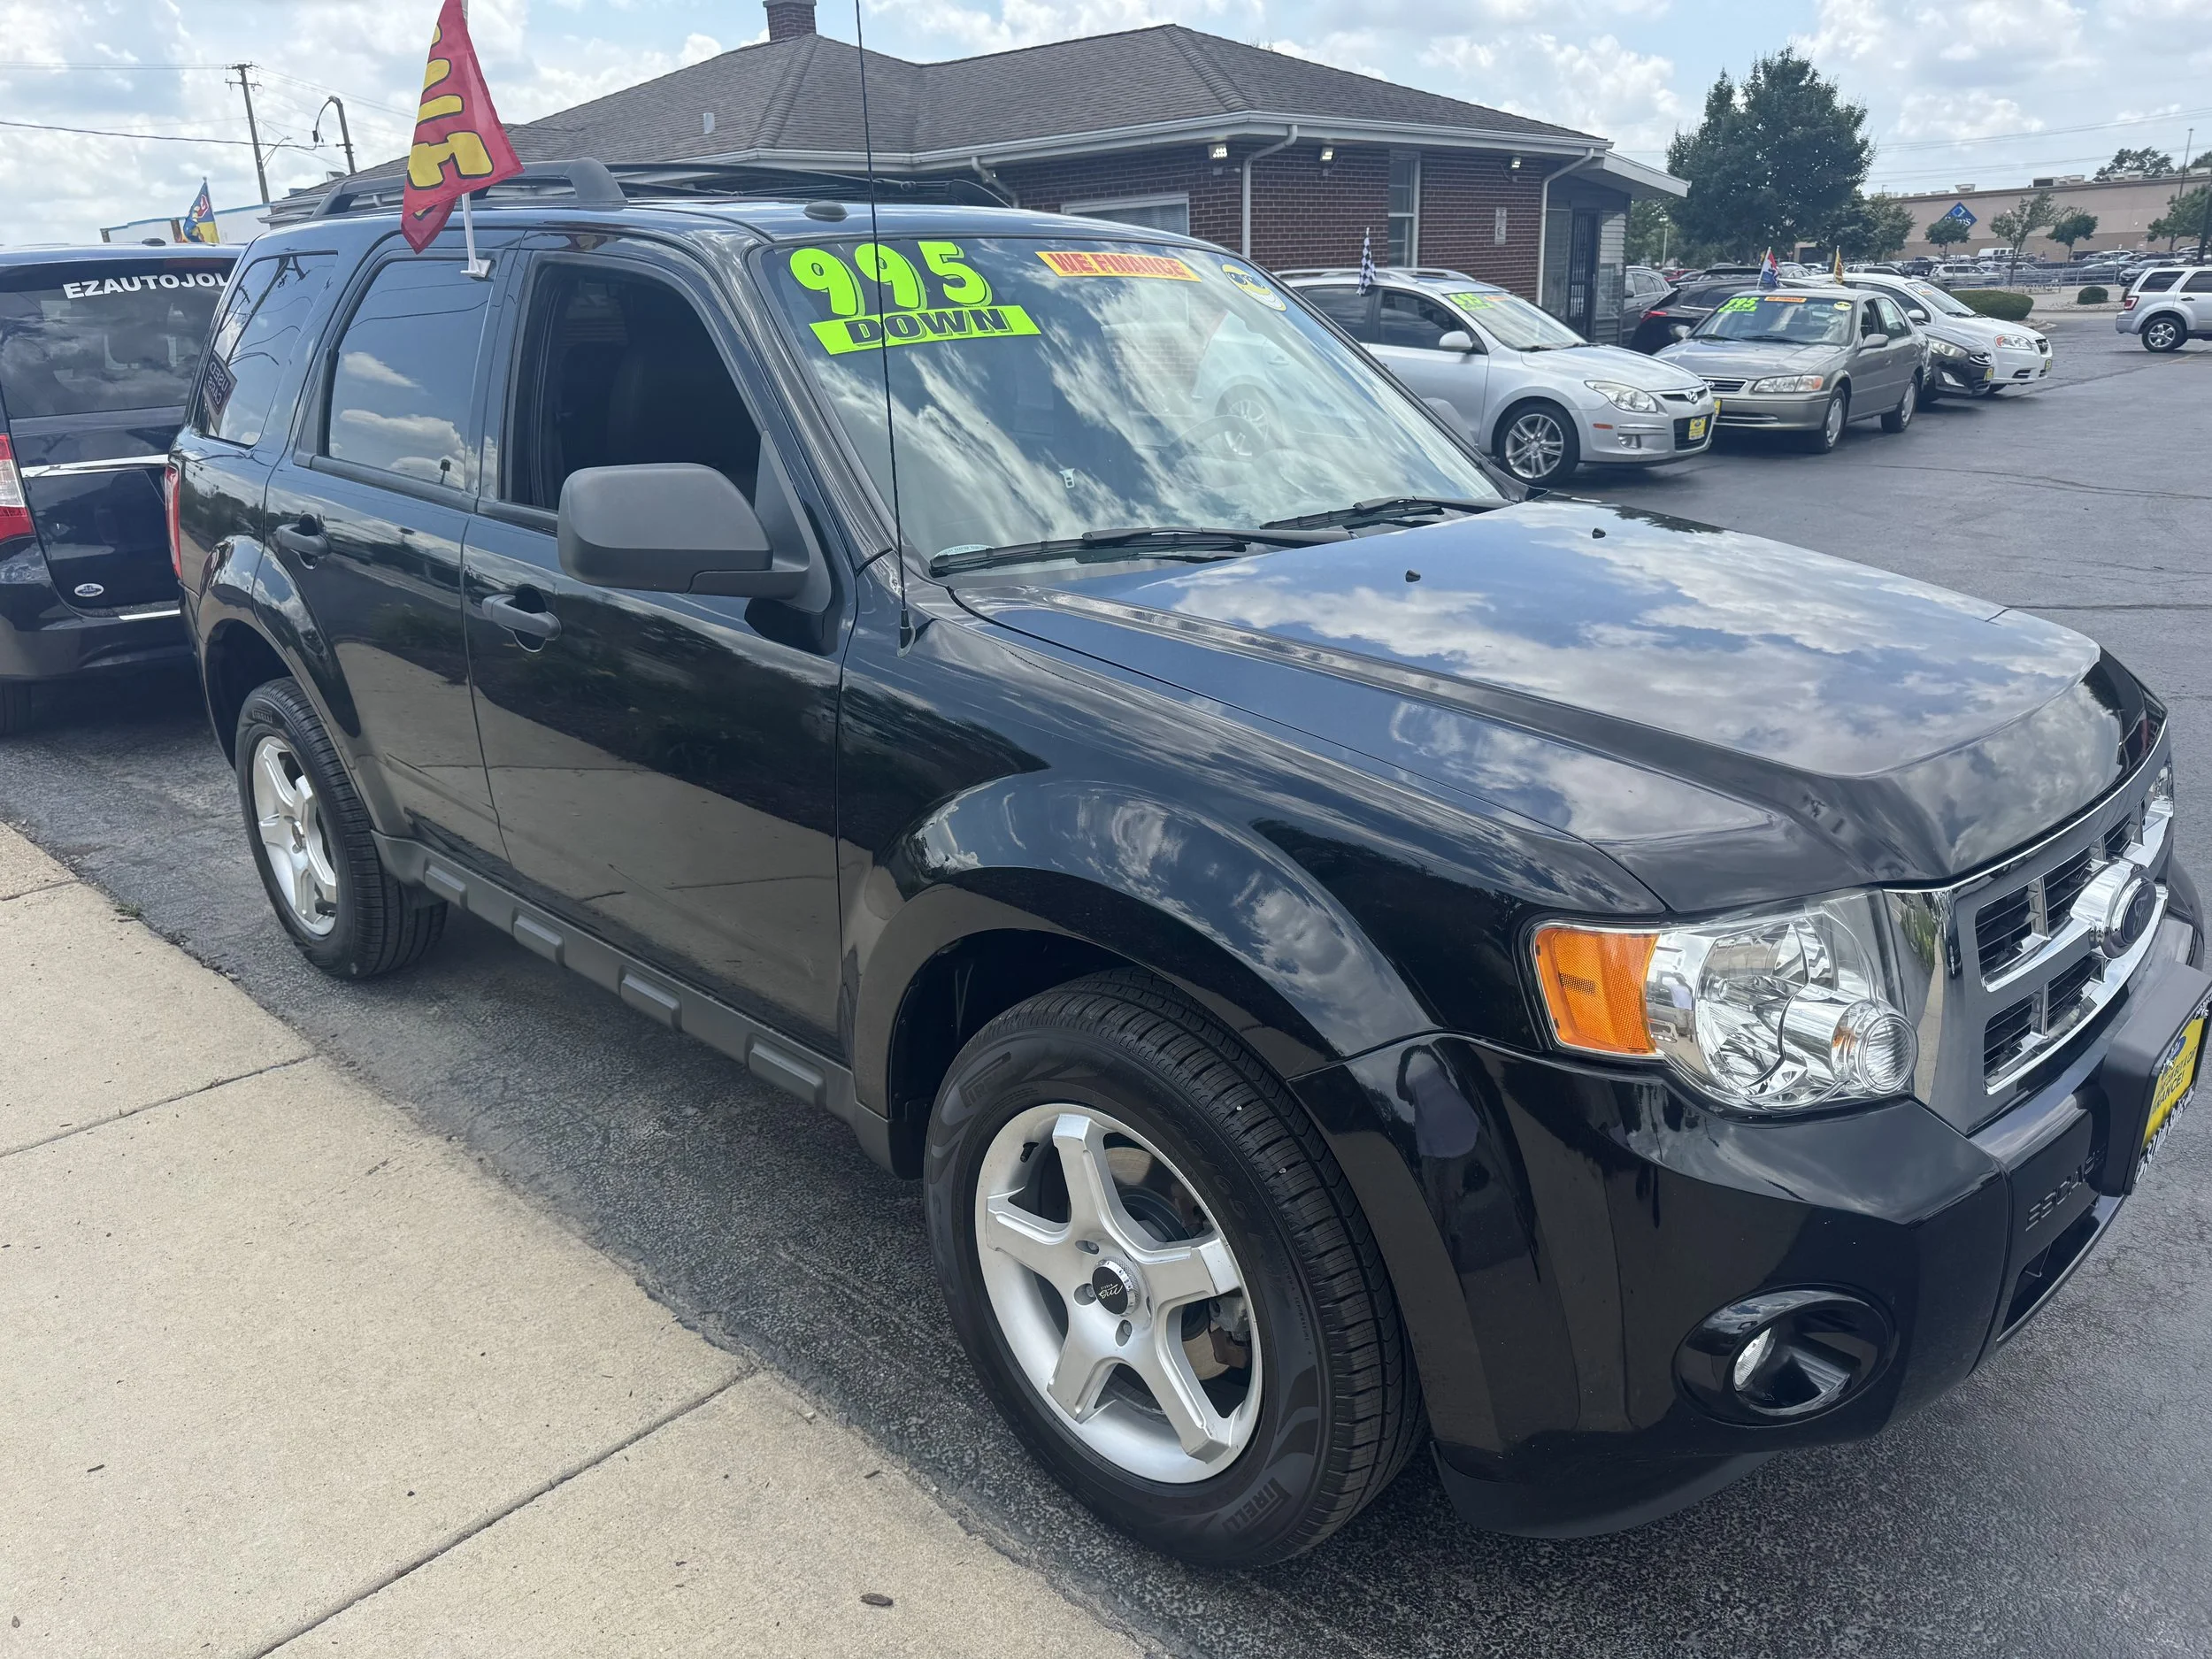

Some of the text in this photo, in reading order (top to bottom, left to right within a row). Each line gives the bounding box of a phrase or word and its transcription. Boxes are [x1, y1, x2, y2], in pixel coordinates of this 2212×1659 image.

[788, 241, 993, 318] 995
[1047, 253, 1193, 279] WE FINANCE
[843, 308, 1014, 347] DOWN
